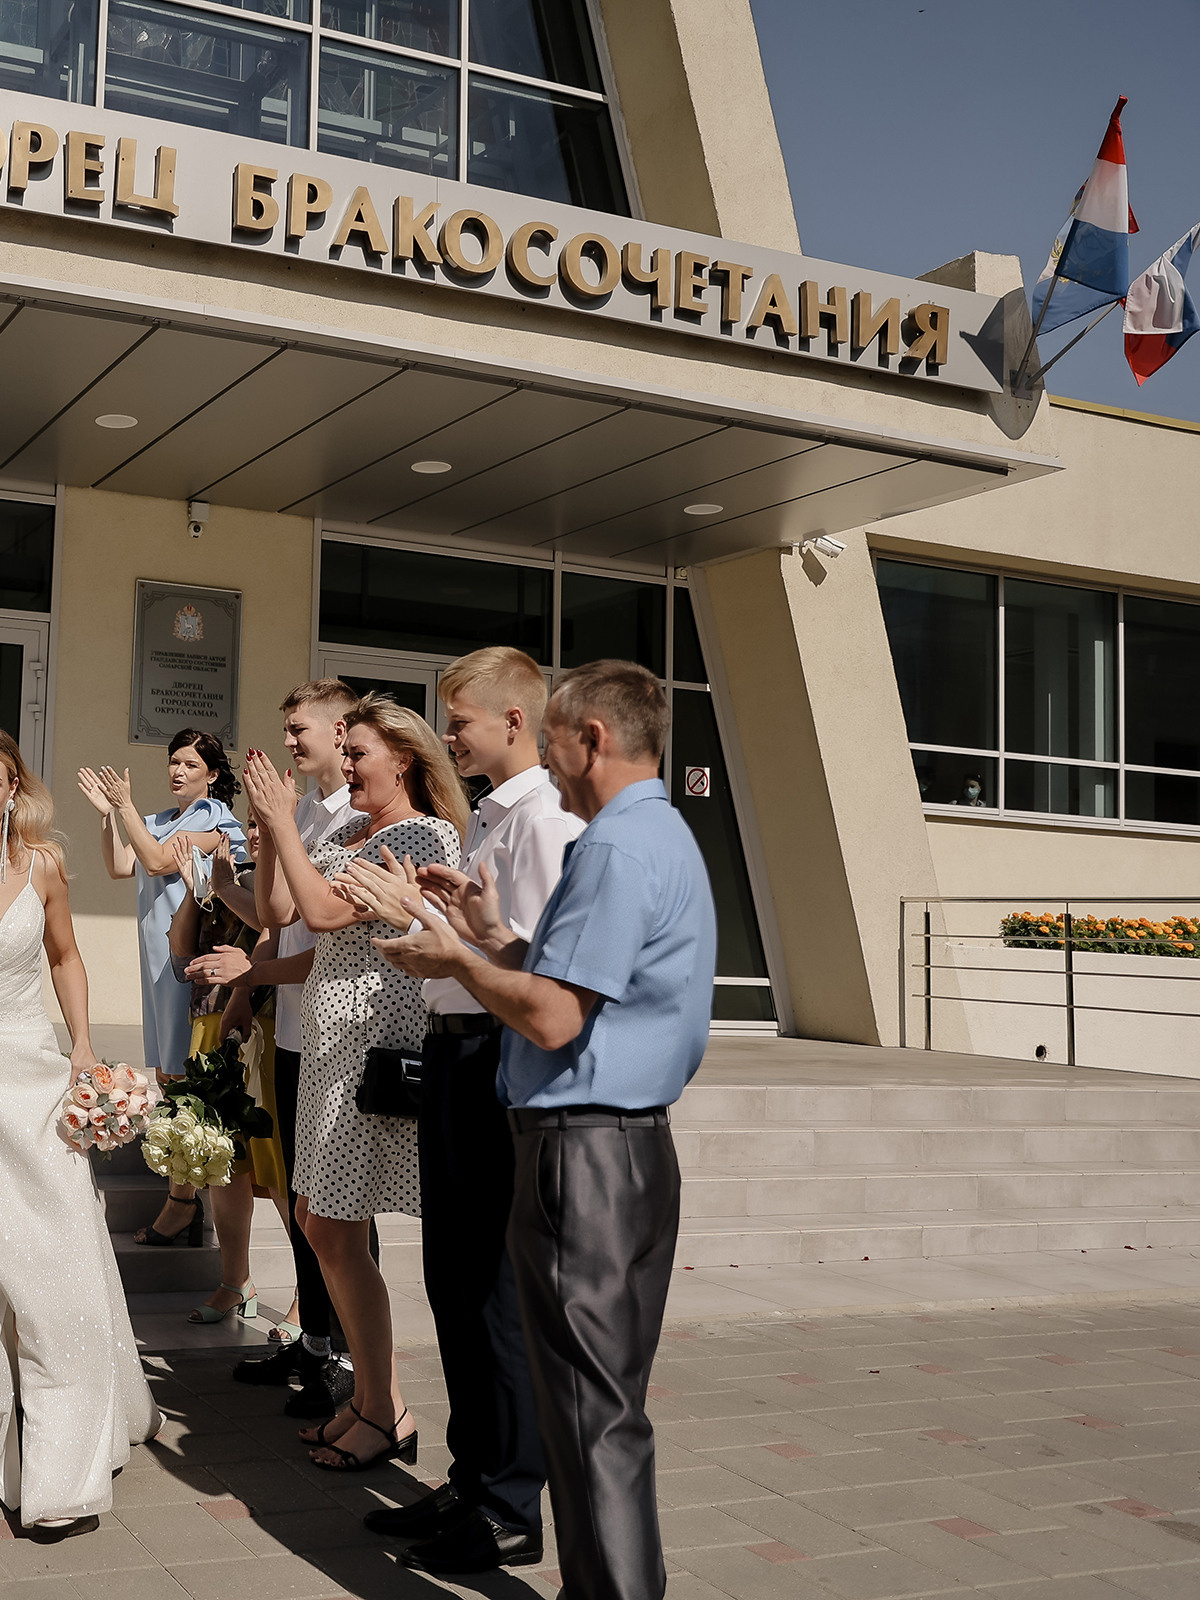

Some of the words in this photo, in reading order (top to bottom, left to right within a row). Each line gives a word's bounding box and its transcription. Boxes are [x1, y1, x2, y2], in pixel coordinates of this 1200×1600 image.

[232, 163, 950, 366] БРАКОСОЧЕТАНИЯ
[172, 682, 204, 691] ДВОРЕЦ
[151, 689, 224, 700] БРАКОСОЧЕТАНИЯ
[161, 698, 213, 708] ГОРОДСКОГО
[155, 706, 185, 715] ОКРУГА
[187, 709, 218, 718] САМАРА
